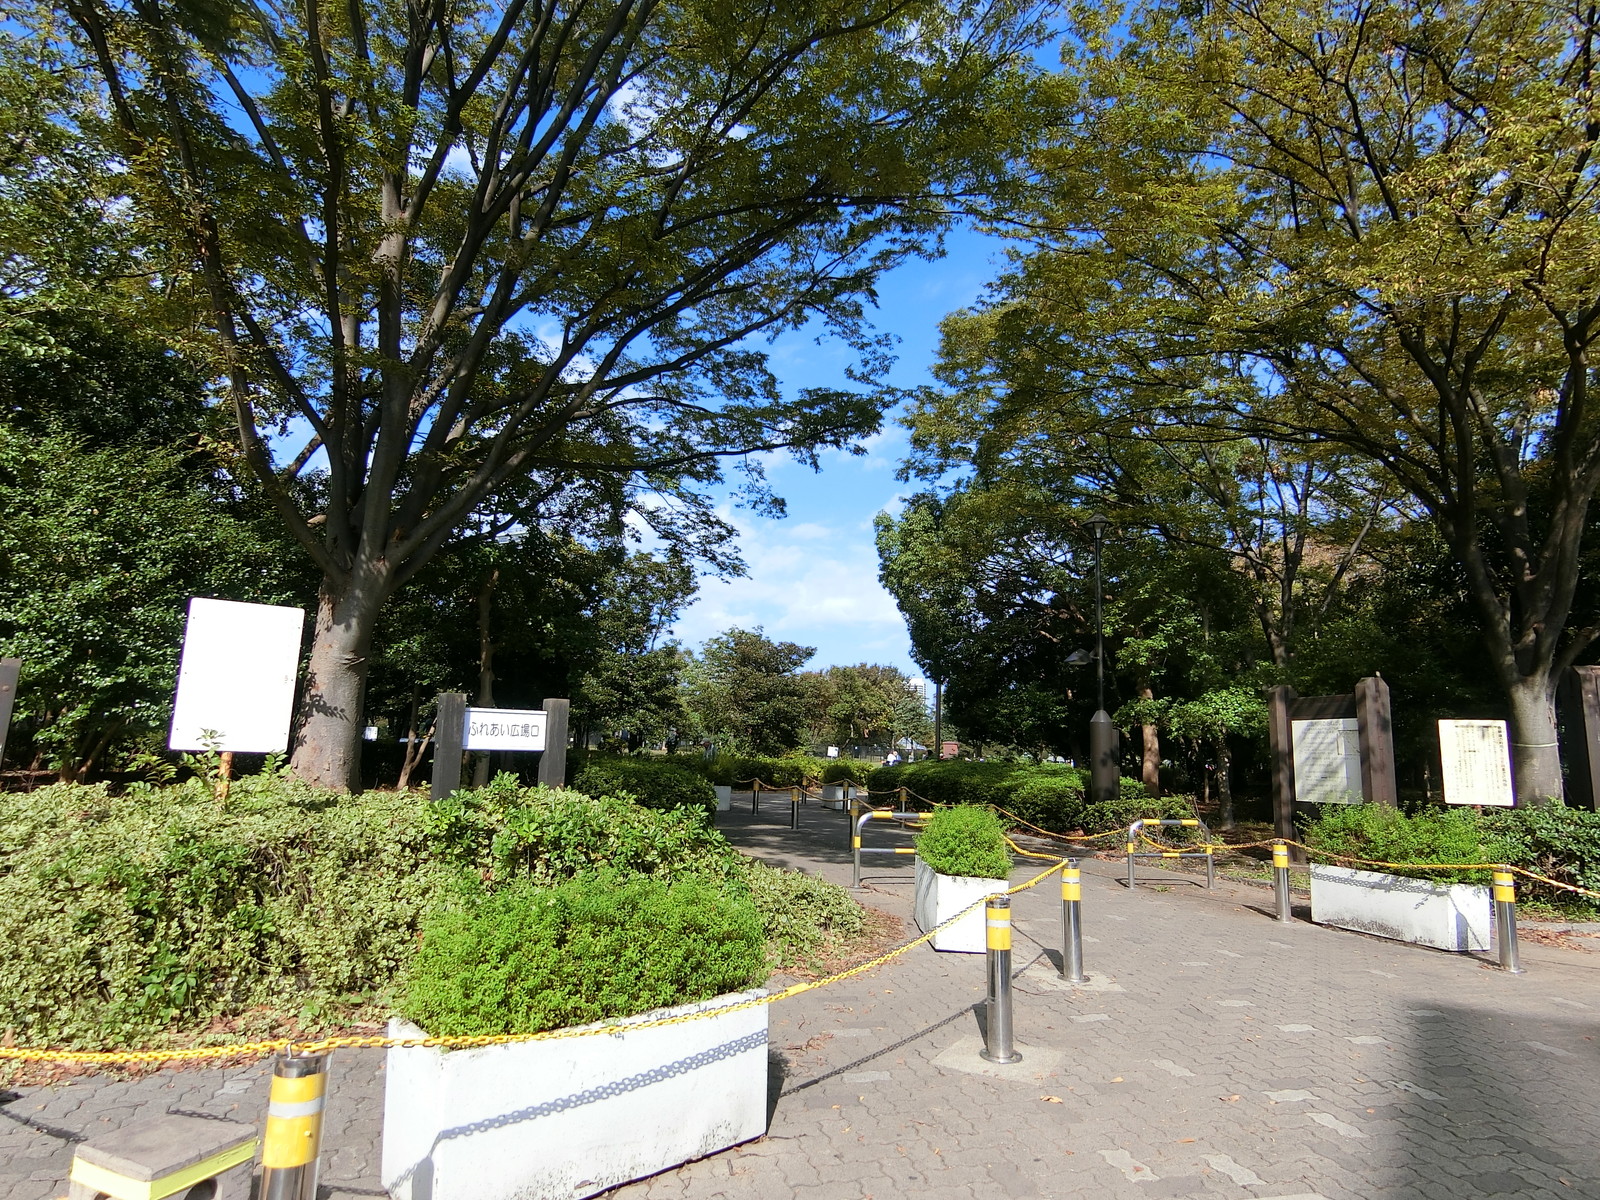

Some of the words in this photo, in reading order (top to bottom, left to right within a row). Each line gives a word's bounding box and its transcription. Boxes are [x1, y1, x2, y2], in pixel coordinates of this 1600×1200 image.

[467, 721, 540, 738] ふれあい広場口
